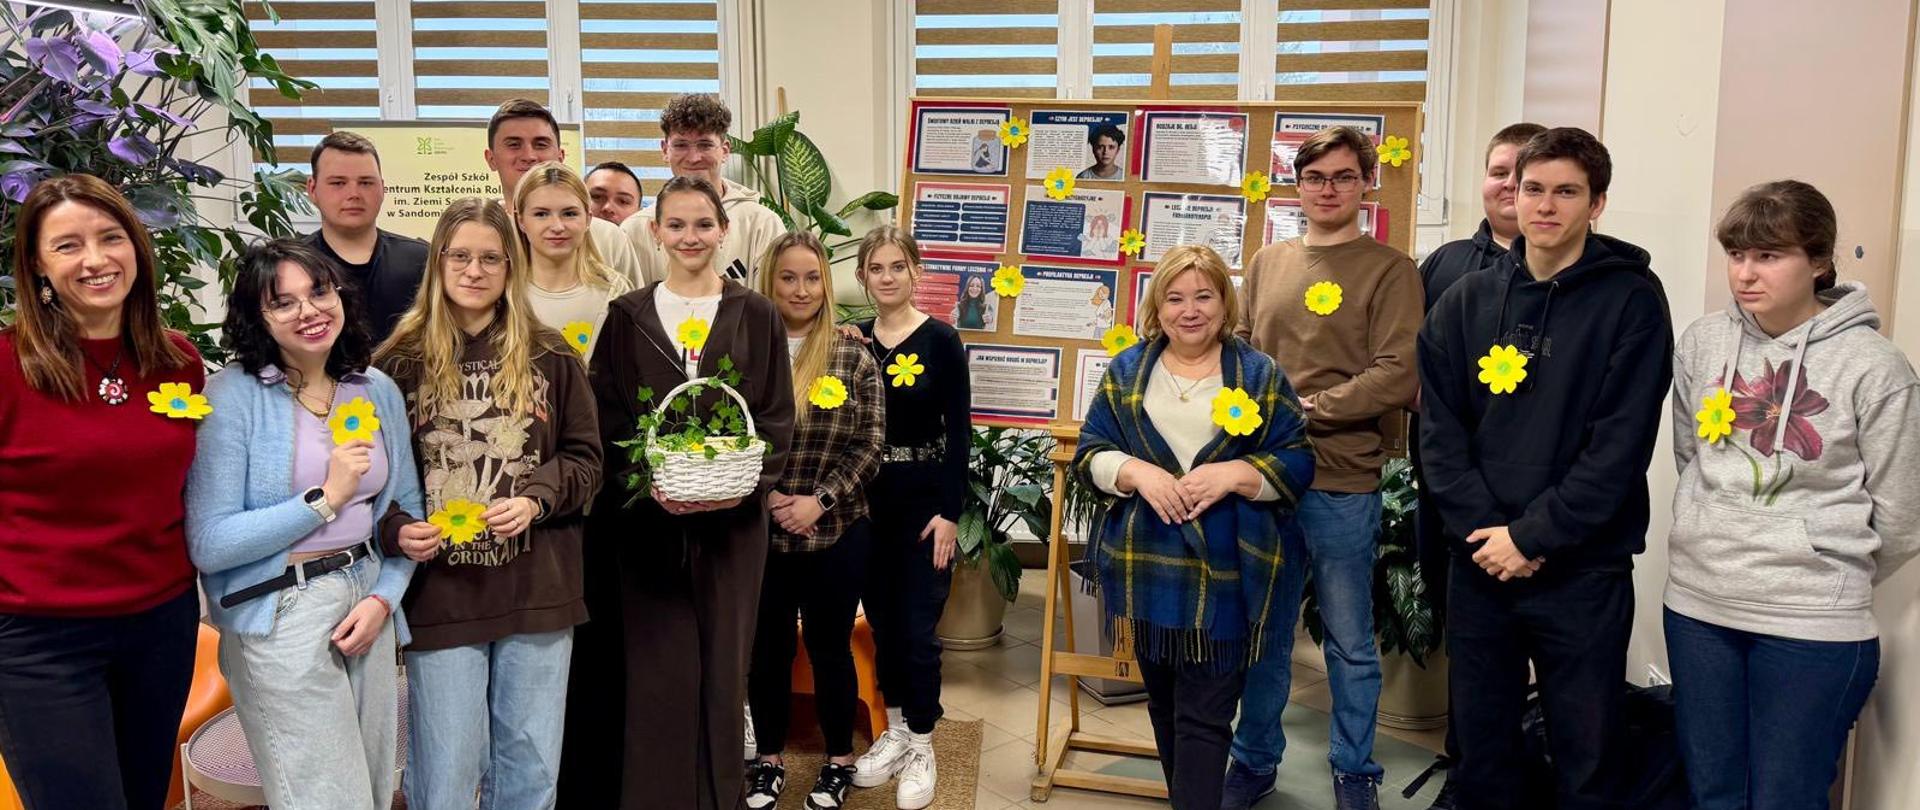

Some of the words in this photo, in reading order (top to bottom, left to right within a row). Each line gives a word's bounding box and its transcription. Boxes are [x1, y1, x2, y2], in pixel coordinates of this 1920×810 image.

[424, 172, 458, 182] Zespół
[462, 172, 489, 181] Szkół
[384, 185, 420, 194] entrum
[424, 185, 481, 194] Kształcenia
[485, 185, 501, 194] Rol
[394, 197, 410, 205] im.
[413, 197, 442, 205] Ziemi
[459, 360, 500, 371] YSTICAL
[472, 541, 491, 550] THE
